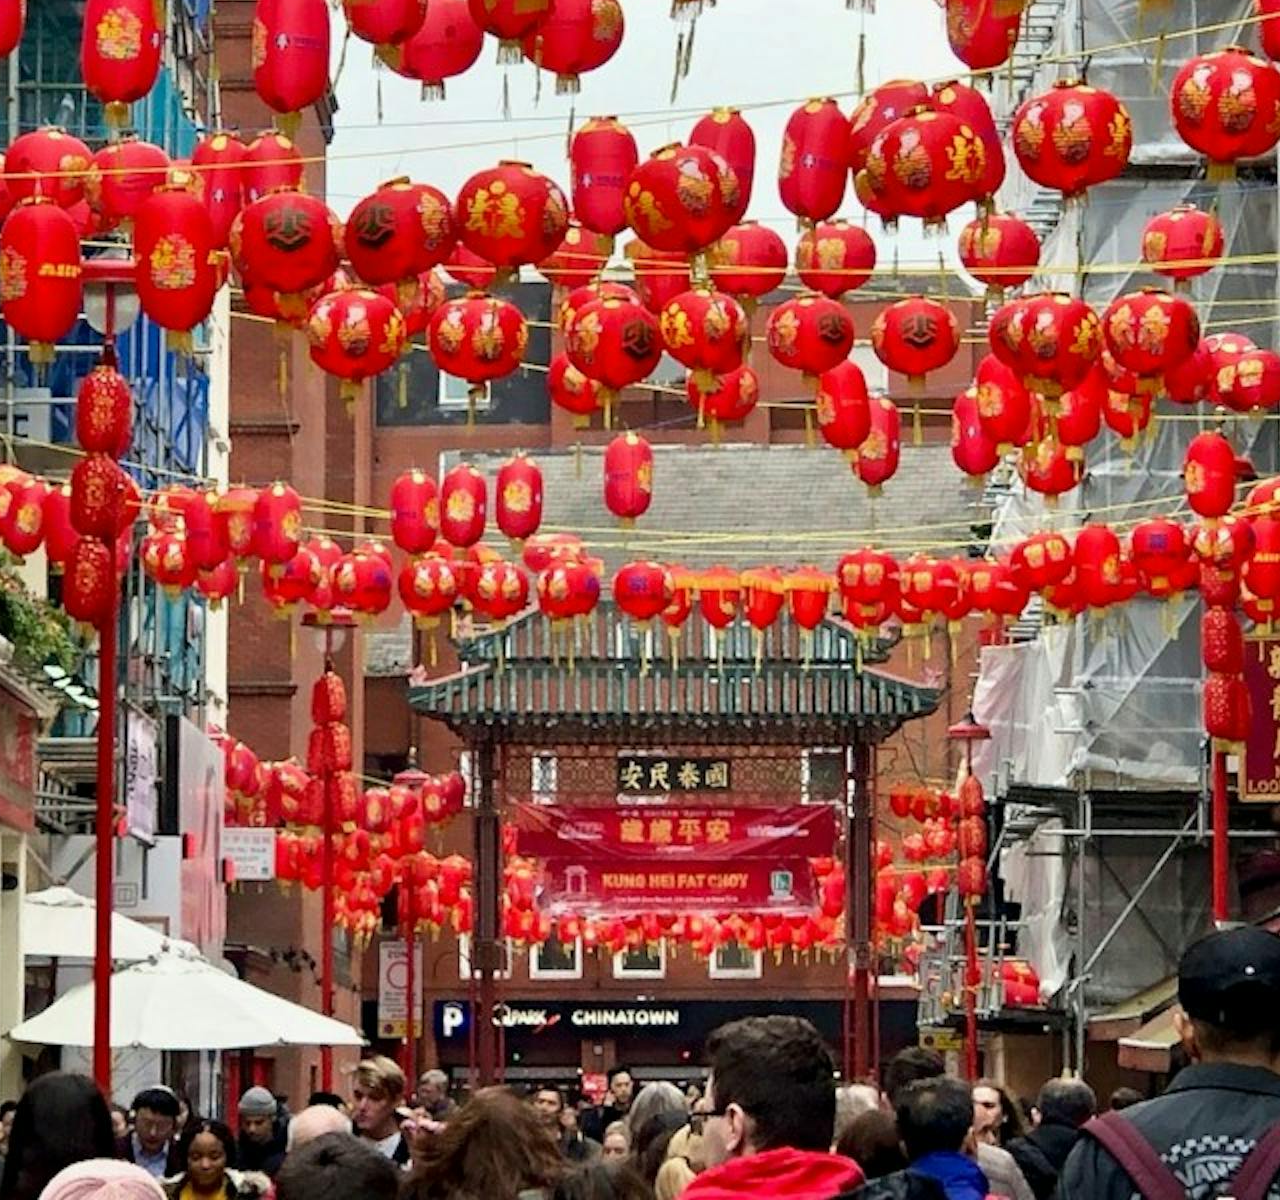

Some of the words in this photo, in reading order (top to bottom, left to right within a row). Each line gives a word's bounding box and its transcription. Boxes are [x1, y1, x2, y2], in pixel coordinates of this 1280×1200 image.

[602, 873, 646, 889] KUNG
[648, 873, 675, 889] HEI
[676, 873, 706, 889] FAT
[707, 873, 749, 889] CHOY
[442, 1004, 464, 1037] P
[571, 1009, 679, 1026] CHINATOWN
